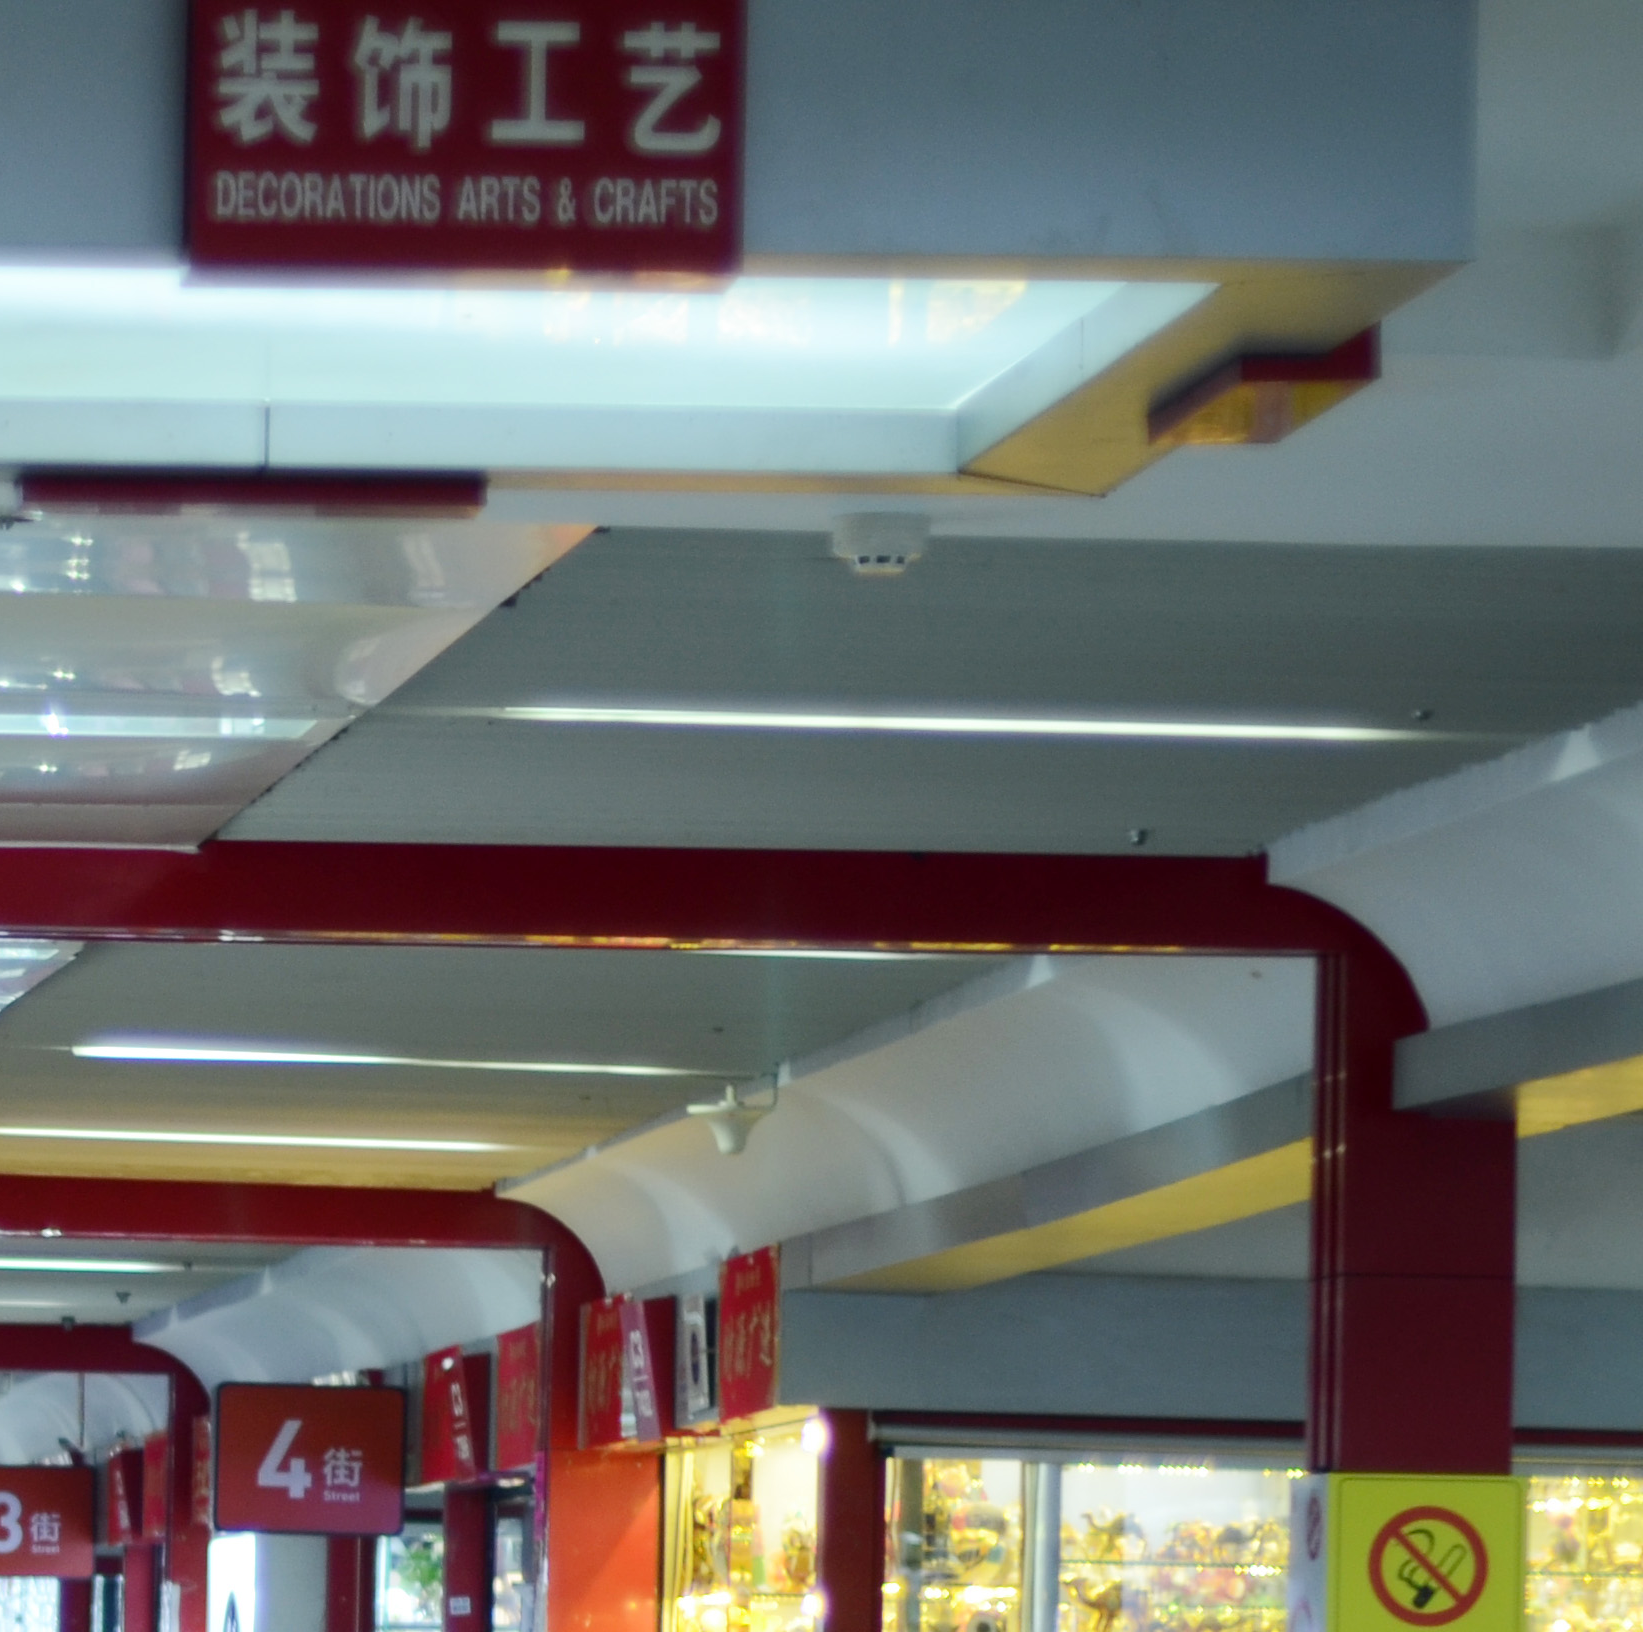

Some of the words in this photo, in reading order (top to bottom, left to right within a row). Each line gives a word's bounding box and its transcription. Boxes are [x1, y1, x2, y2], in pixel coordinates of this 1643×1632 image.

[217, 8, 723, 154] 装饰工艺
[215, 171, 441, 224] DECORATIONS
[459, 175, 542, 224] ARTS
[557, 177, 577, 224] &
[593, 177, 720, 227] CRAFTS
[323, 1490, 361, 1501] Street
